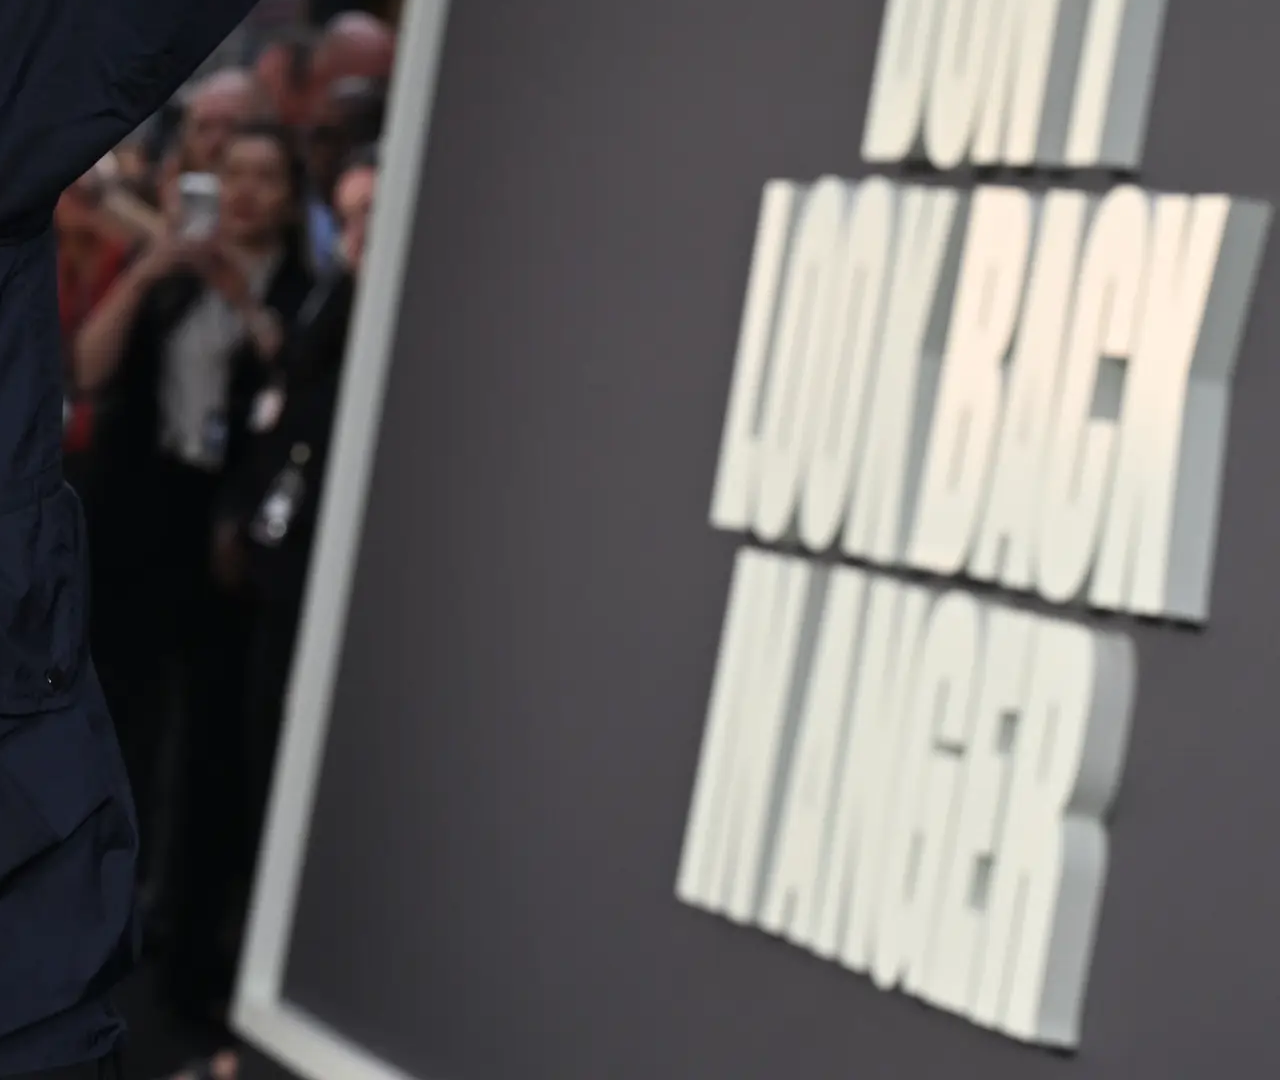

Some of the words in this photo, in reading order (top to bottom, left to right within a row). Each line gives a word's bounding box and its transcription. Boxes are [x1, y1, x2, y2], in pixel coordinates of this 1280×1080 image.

[709, 175, 960, 568] LOOK
[905, 182, 1234, 618] BACK
[674, 545, 815, 927] IN
[756, 560, 1098, 1043] ANGER
